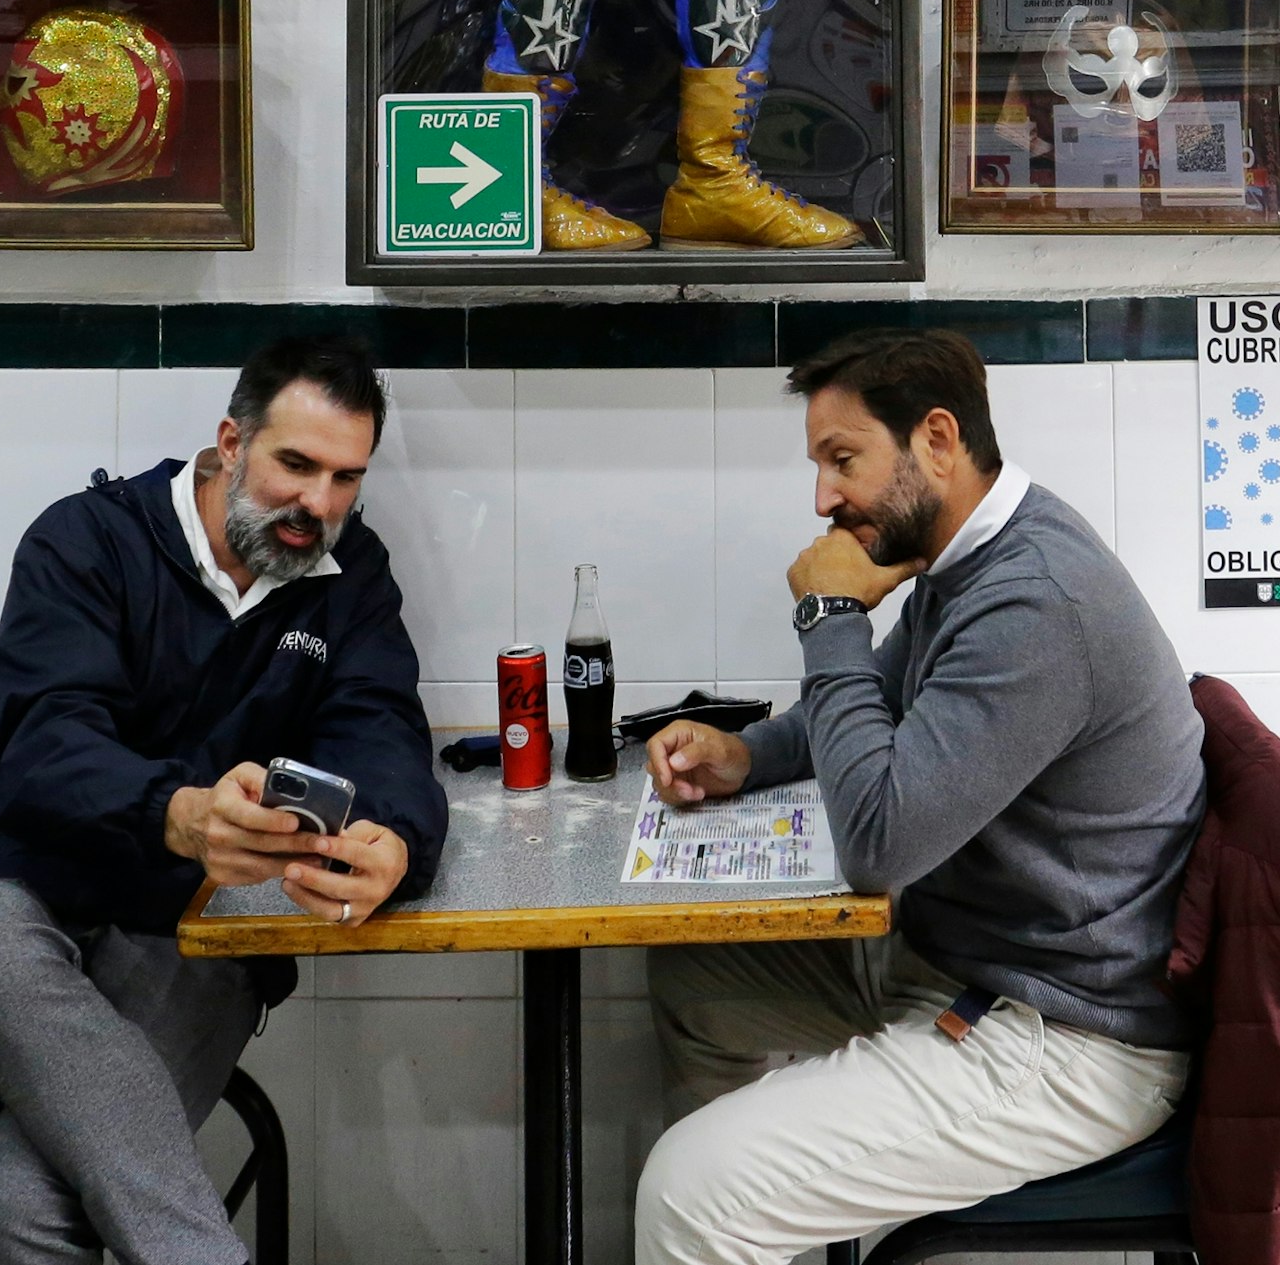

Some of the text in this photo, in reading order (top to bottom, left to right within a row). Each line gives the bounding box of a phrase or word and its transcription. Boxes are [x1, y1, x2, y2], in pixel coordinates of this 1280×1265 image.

[419, 112, 501, 129] RUTA DE
[397, 222, 521, 240] EVACUACION
